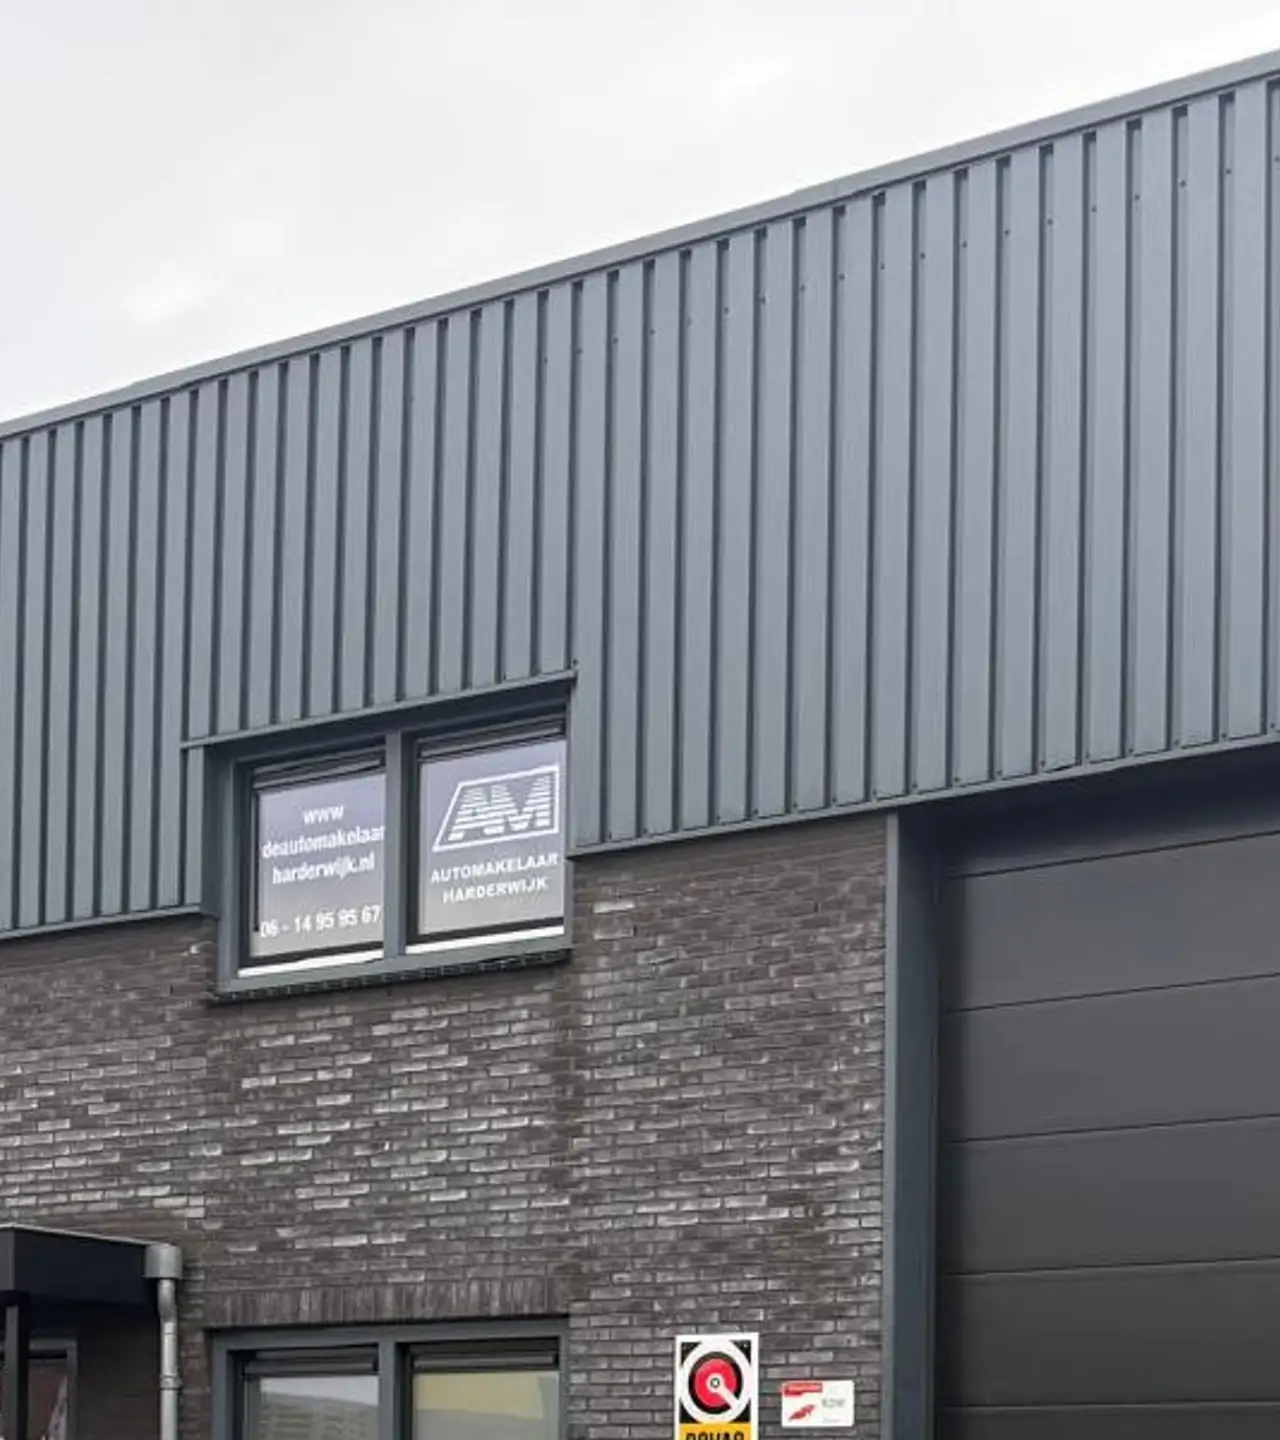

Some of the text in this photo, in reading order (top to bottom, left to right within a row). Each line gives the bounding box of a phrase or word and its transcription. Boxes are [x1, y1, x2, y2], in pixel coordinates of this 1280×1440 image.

[303, 805, 344, 824] www
[261, 825, 385, 859] deautomakelaar
[272, 849, 375, 884] harderwijk.nl
[430, 852, 558, 884] AUTOMAKELAAR
[442, 876, 550, 904] HARDERWIJK
[260, 918, 279, 938] 06
[294, 914, 311, 933] 14
[361, 904, 381, 924] 67
